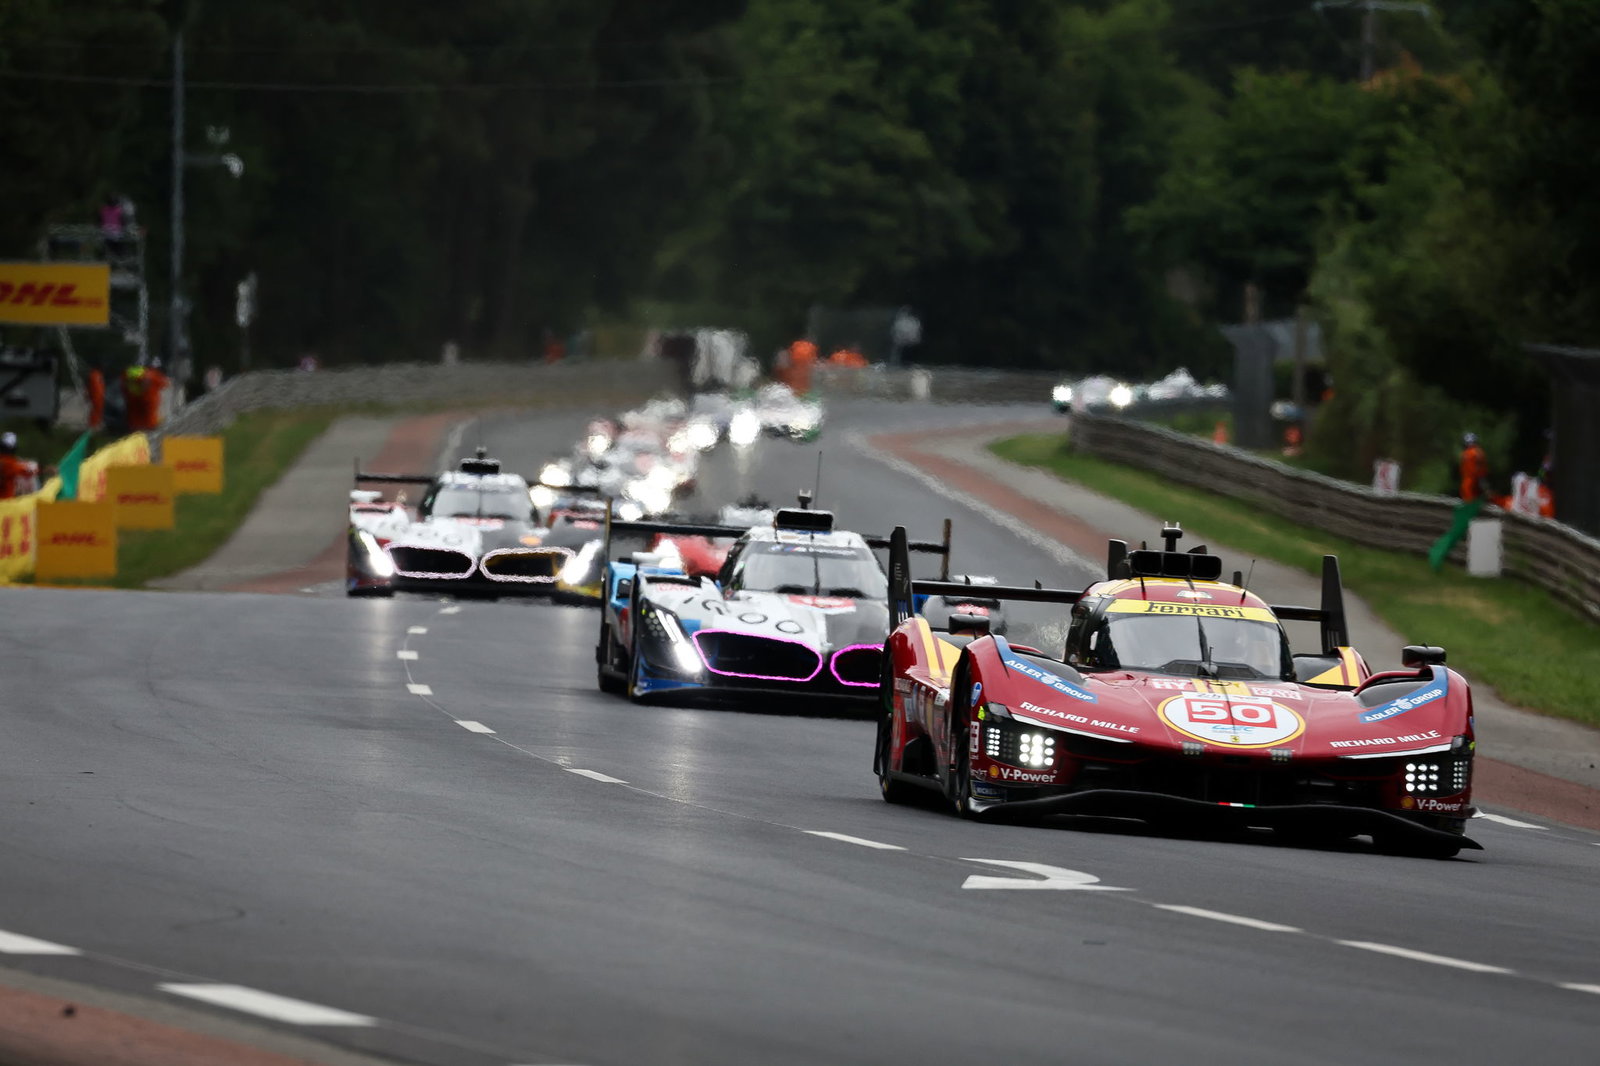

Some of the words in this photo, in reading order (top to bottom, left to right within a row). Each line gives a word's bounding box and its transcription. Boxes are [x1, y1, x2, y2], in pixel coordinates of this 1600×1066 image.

[1144, 602, 1246, 618] Ferrari
[1004, 659, 1042, 679] ADLER
[1053, 682, 1094, 702] GROUP
[1190, 701, 1272, 724] 50
[1363, 706, 1402, 723] ADLER
[1412, 688, 1444, 705] GROUP
[1019, 701, 1089, 724] RICHARD
[1090, 719, 1141, 734] MILLE
[1329, 736, 1397, 748] RICHARD
[1397, 730, 1442, 743] MILLE
[1000, 767, 1057, 784] V-Power
[1416, 798, 1461, 812] V-Power
